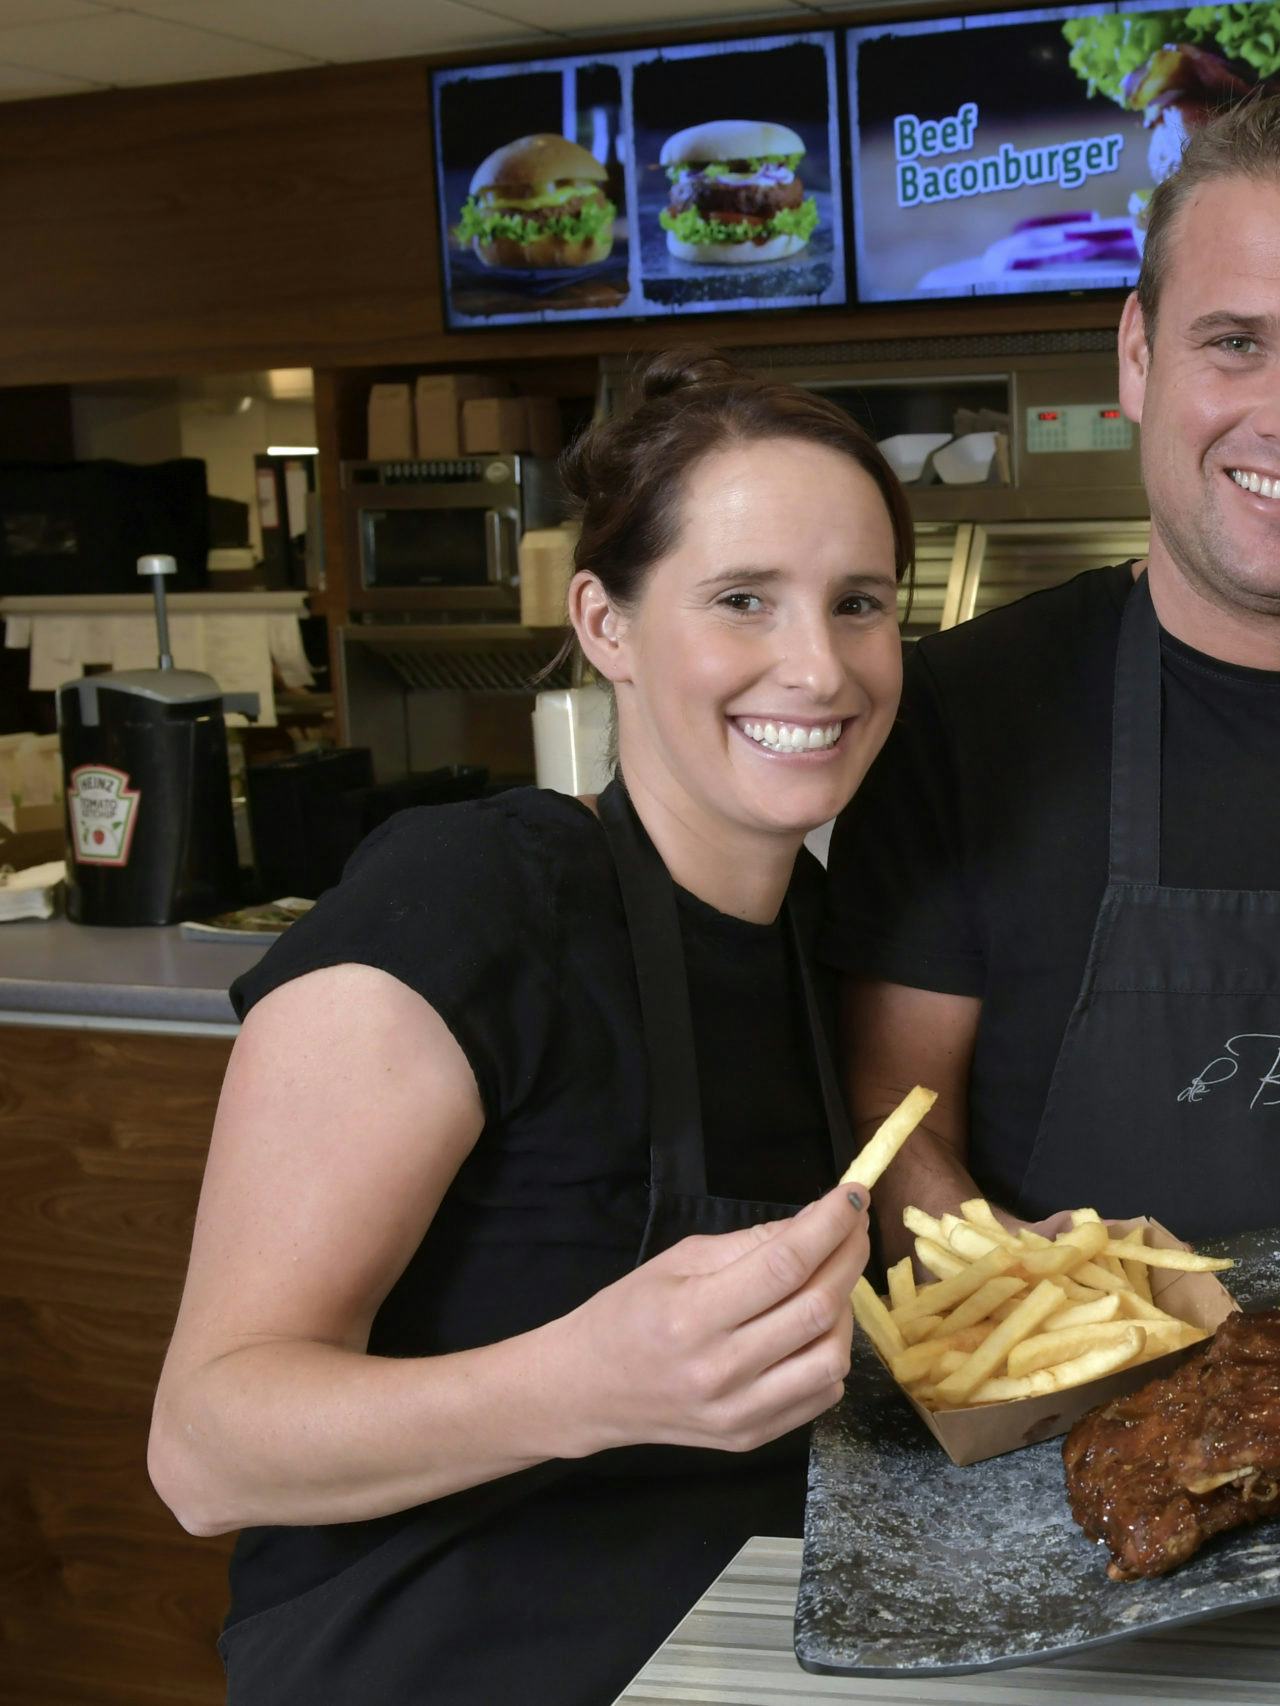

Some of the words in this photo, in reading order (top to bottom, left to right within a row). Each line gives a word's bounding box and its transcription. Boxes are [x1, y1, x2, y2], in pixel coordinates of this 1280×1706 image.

[896, 104, 976, 159] Beef
[899, 137, 1121, 204] Baconburger
[80, 798, 118, 809] TOMATO
[81, 776, 115, 793] HEINZ
[1177, 1056, 1239, 1103] de
